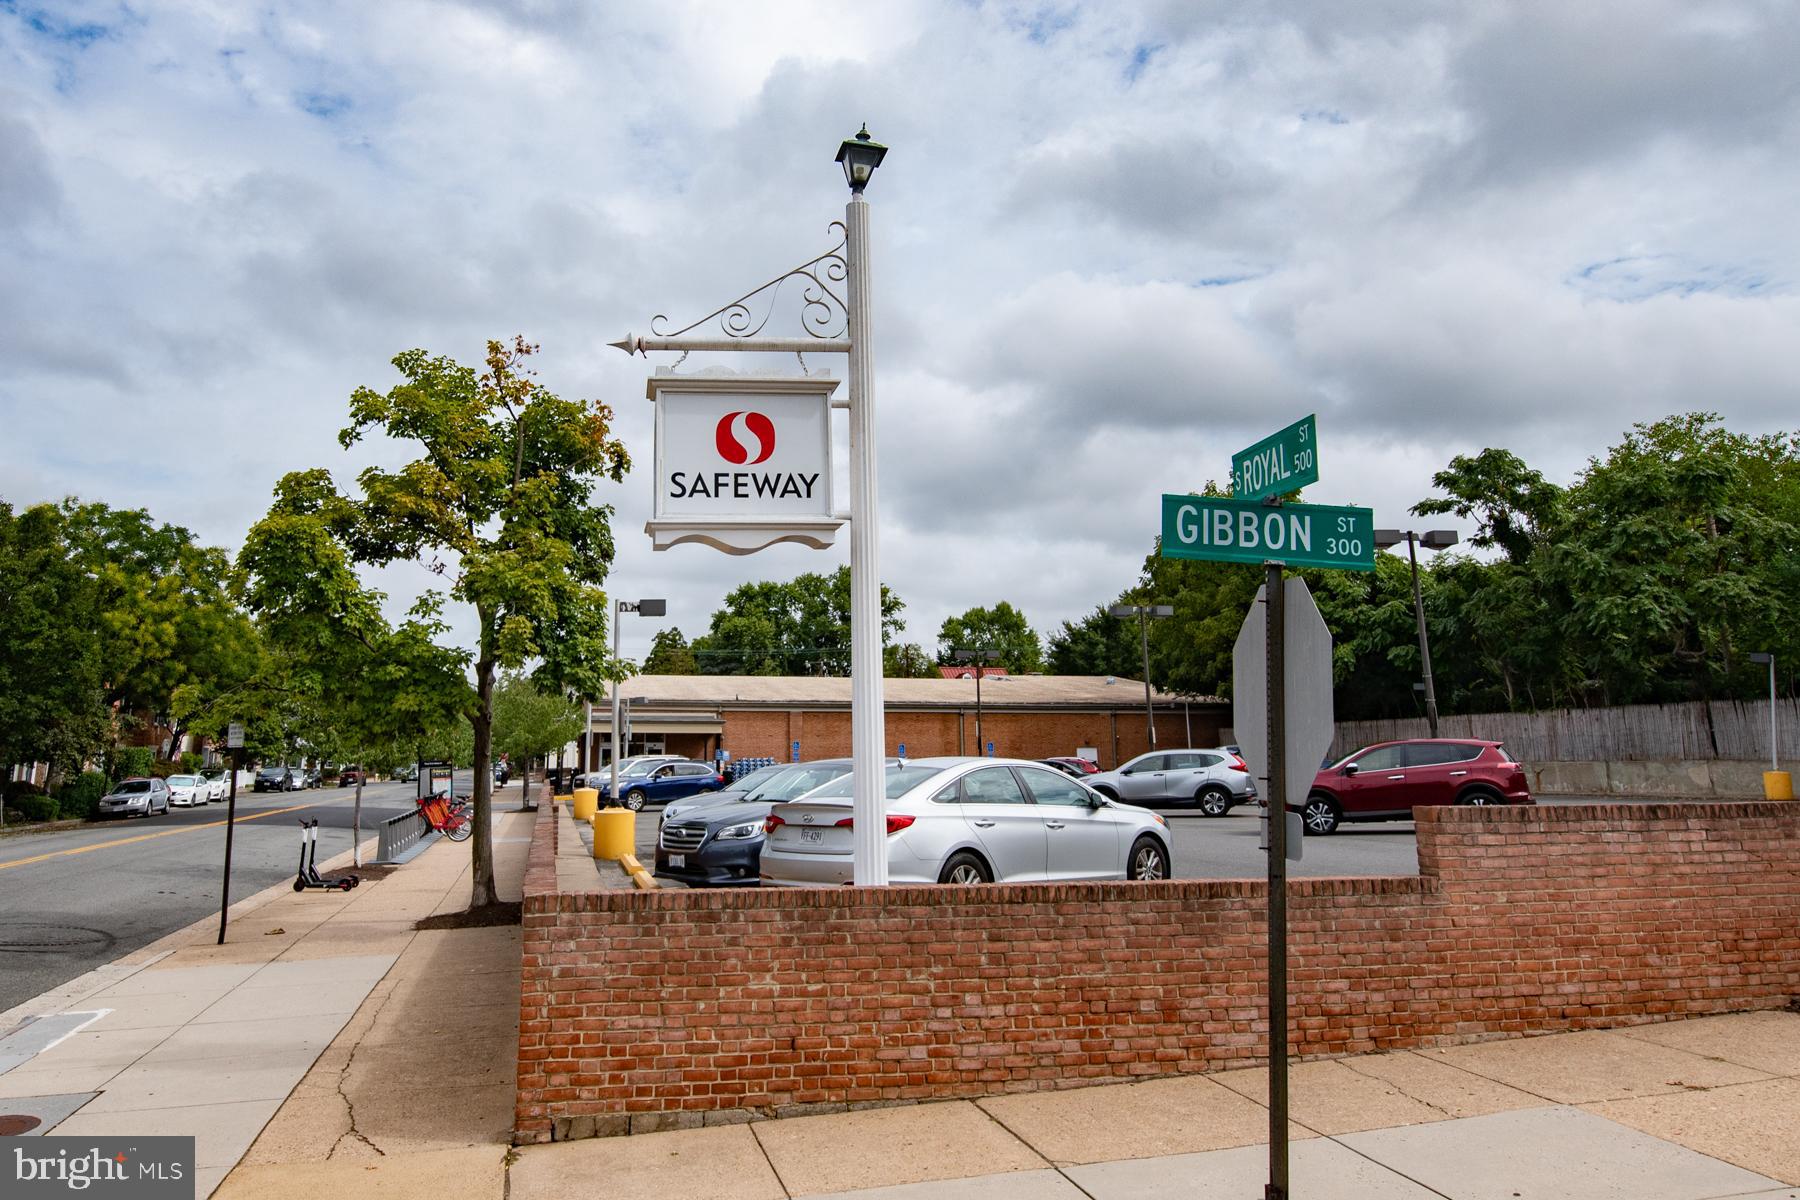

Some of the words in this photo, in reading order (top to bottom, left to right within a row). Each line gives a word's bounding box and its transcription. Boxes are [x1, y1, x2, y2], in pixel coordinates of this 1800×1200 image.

[1299, 424, 1309, 443] ST
[1235, 471, 1242, 491] S
[1243, 443, 1291, 495] ROYAL
[1294, 449, 1312, 473] 500
[670, 472, 820, 499] SAFEWAY
[1176, 504, 1311, 551] GIBBON
[1337, 517, 1356, 534] ST
[1326, 538, 1362, 556] 300
